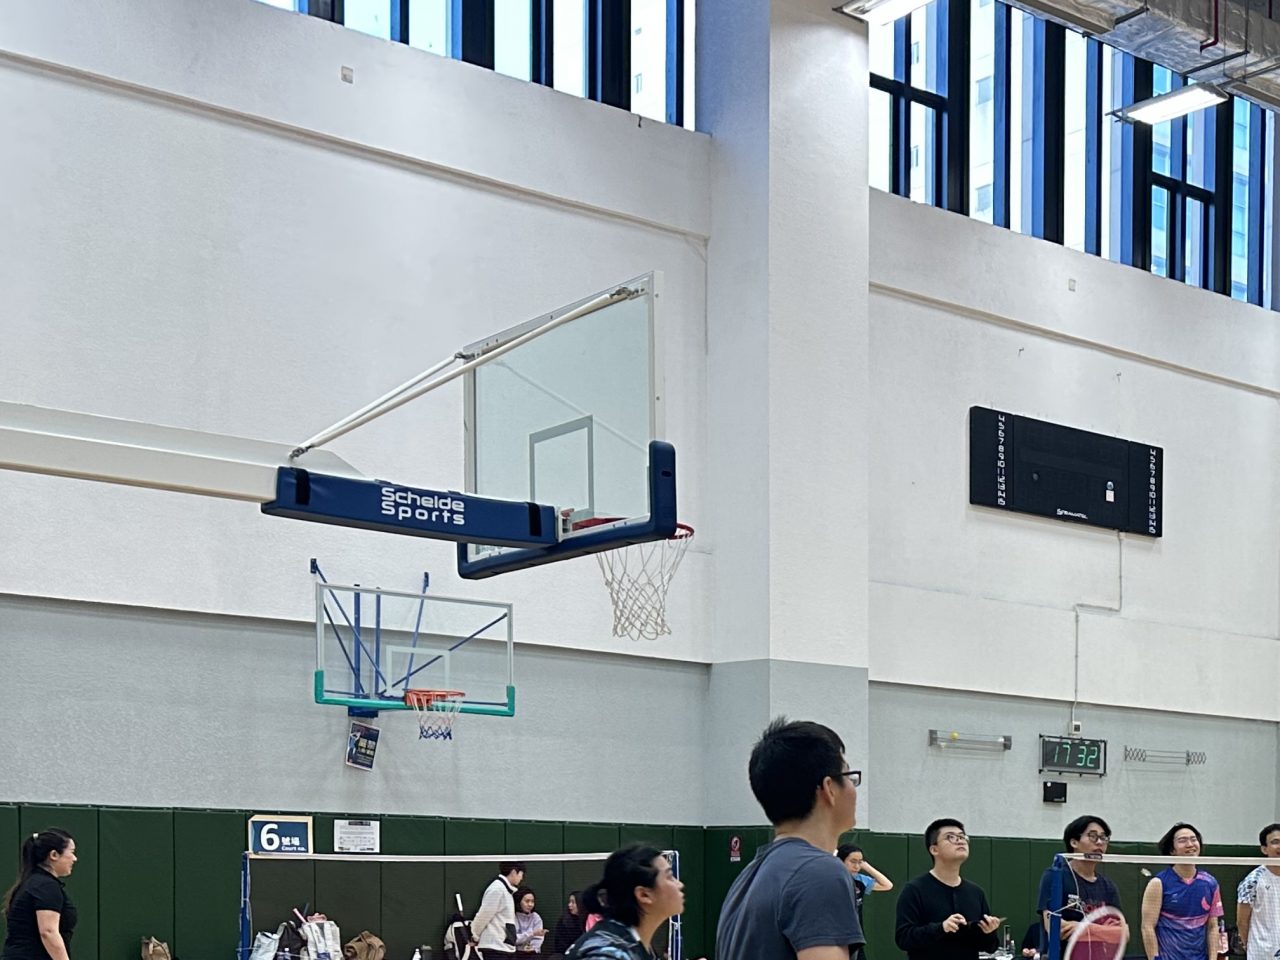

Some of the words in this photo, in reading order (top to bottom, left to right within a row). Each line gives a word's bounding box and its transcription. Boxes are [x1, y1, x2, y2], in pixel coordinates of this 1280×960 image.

[381, 487, 465, 512] Schelde
[381, 501, 465, 525] Sports
[1054, 744, 1071, 764] 17
[1076, 746, 1098, 767] 32
[260, 823, 280, 851] 6
